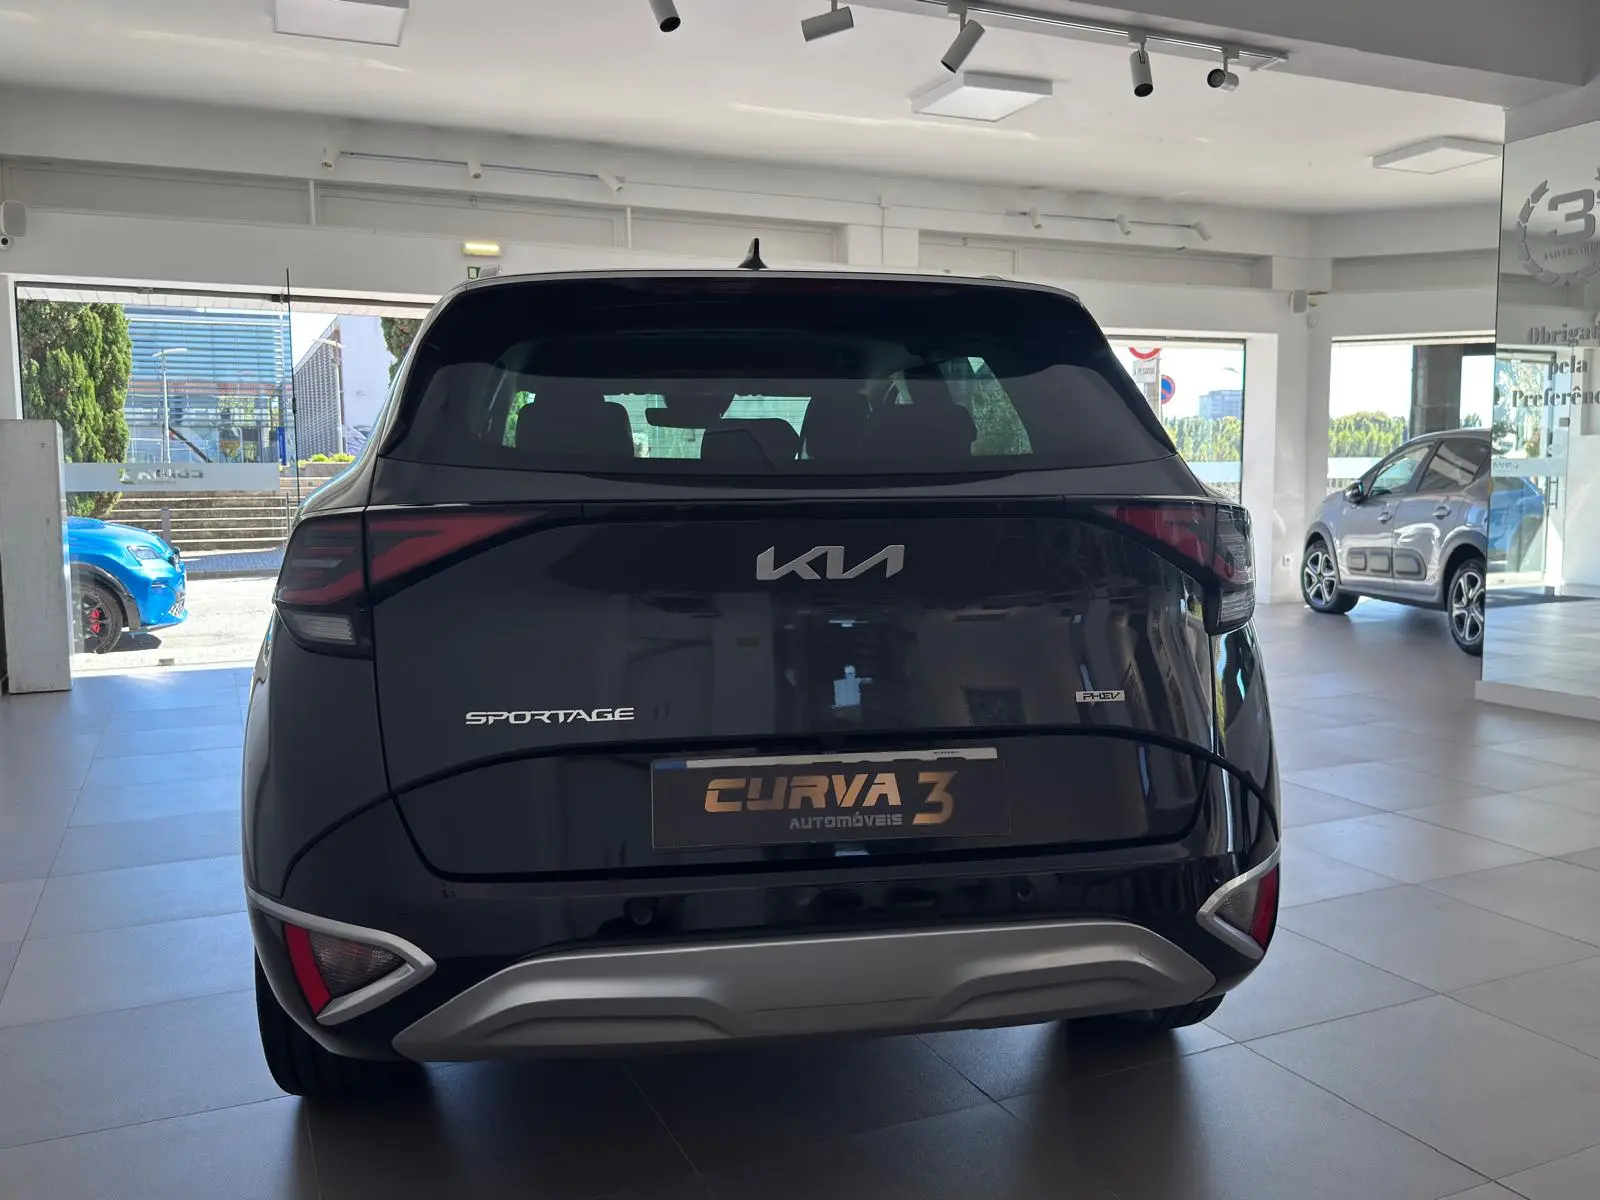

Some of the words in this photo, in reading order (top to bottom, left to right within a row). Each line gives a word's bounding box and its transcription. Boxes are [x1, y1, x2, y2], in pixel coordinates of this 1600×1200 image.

[1548, 355, 1588, 380] pela
[756, 544, 905, 580] KIA
[1082, 692, 1121, 701] PHEV
[465, 707, 635, 725] SPORTAGE
[704, 773, 902, 813] CURVA
[912, 770, 958, 825] 3
[789, 812, 903, 830] AUTOMÓVEIS
